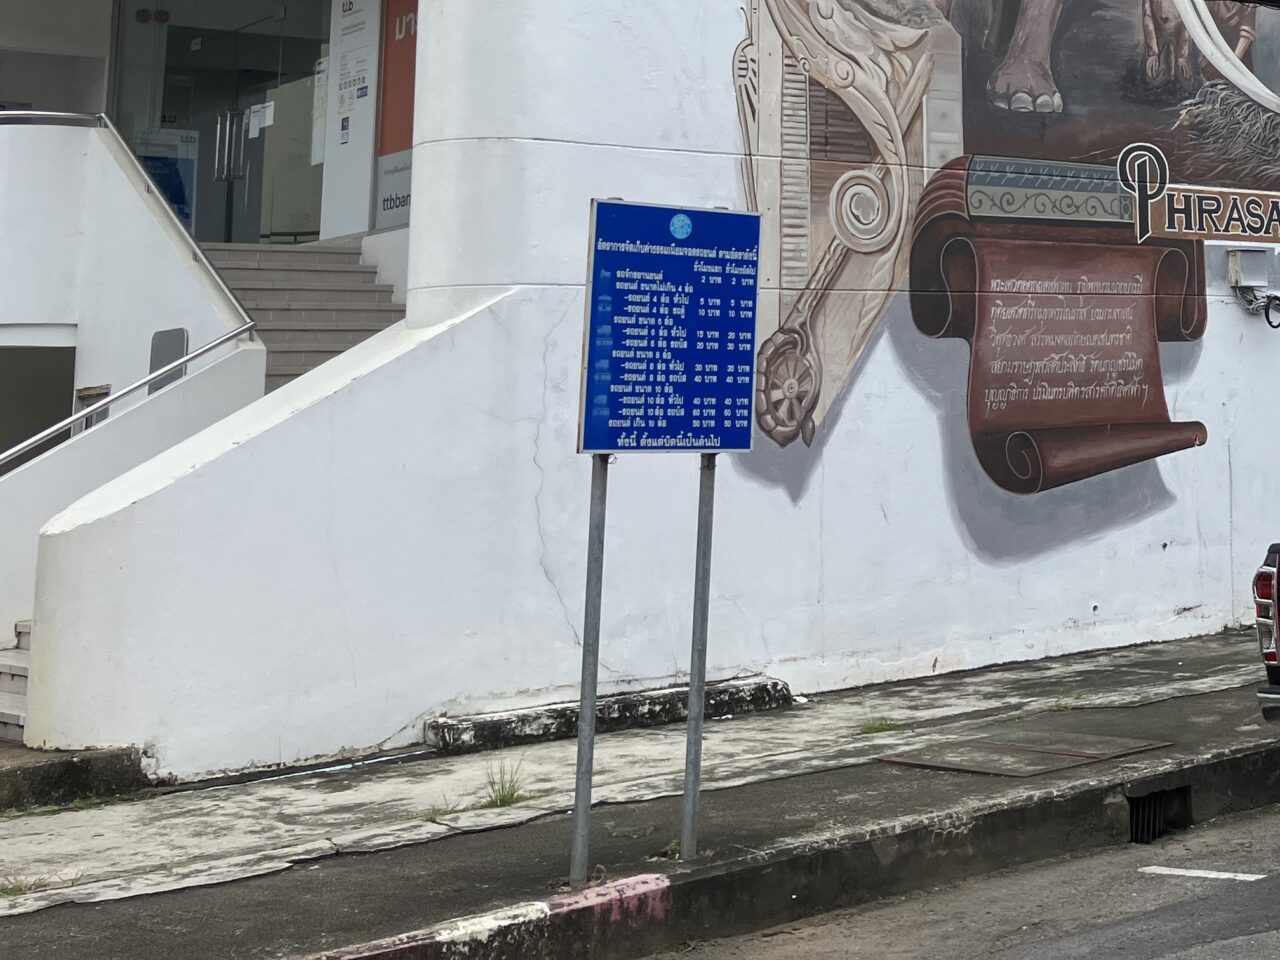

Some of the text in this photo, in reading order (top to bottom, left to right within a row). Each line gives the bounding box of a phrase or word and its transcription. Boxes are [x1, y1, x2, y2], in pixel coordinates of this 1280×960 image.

[709, 276, 722, 284] บาท
[742, 278, 754, 286] บาท
[708, 298, 721, 306] บาท
[708, 309, 720, 317] บาท
[740, 310, 752, 318] บาท
[706, 342, 719, 350] บาท
[739, 343, 751, 351] บาท
[705, 364, 718, 372] บาท
[705, 375, 717, 383] บาท
[737, 376, 750, 384] บาท
[703, 397, 716, 405] บาท
[736, 409, 748, 417] บาท
[702, 420, 715, 428] บาท
[735, 420, 748, 428] บาท
